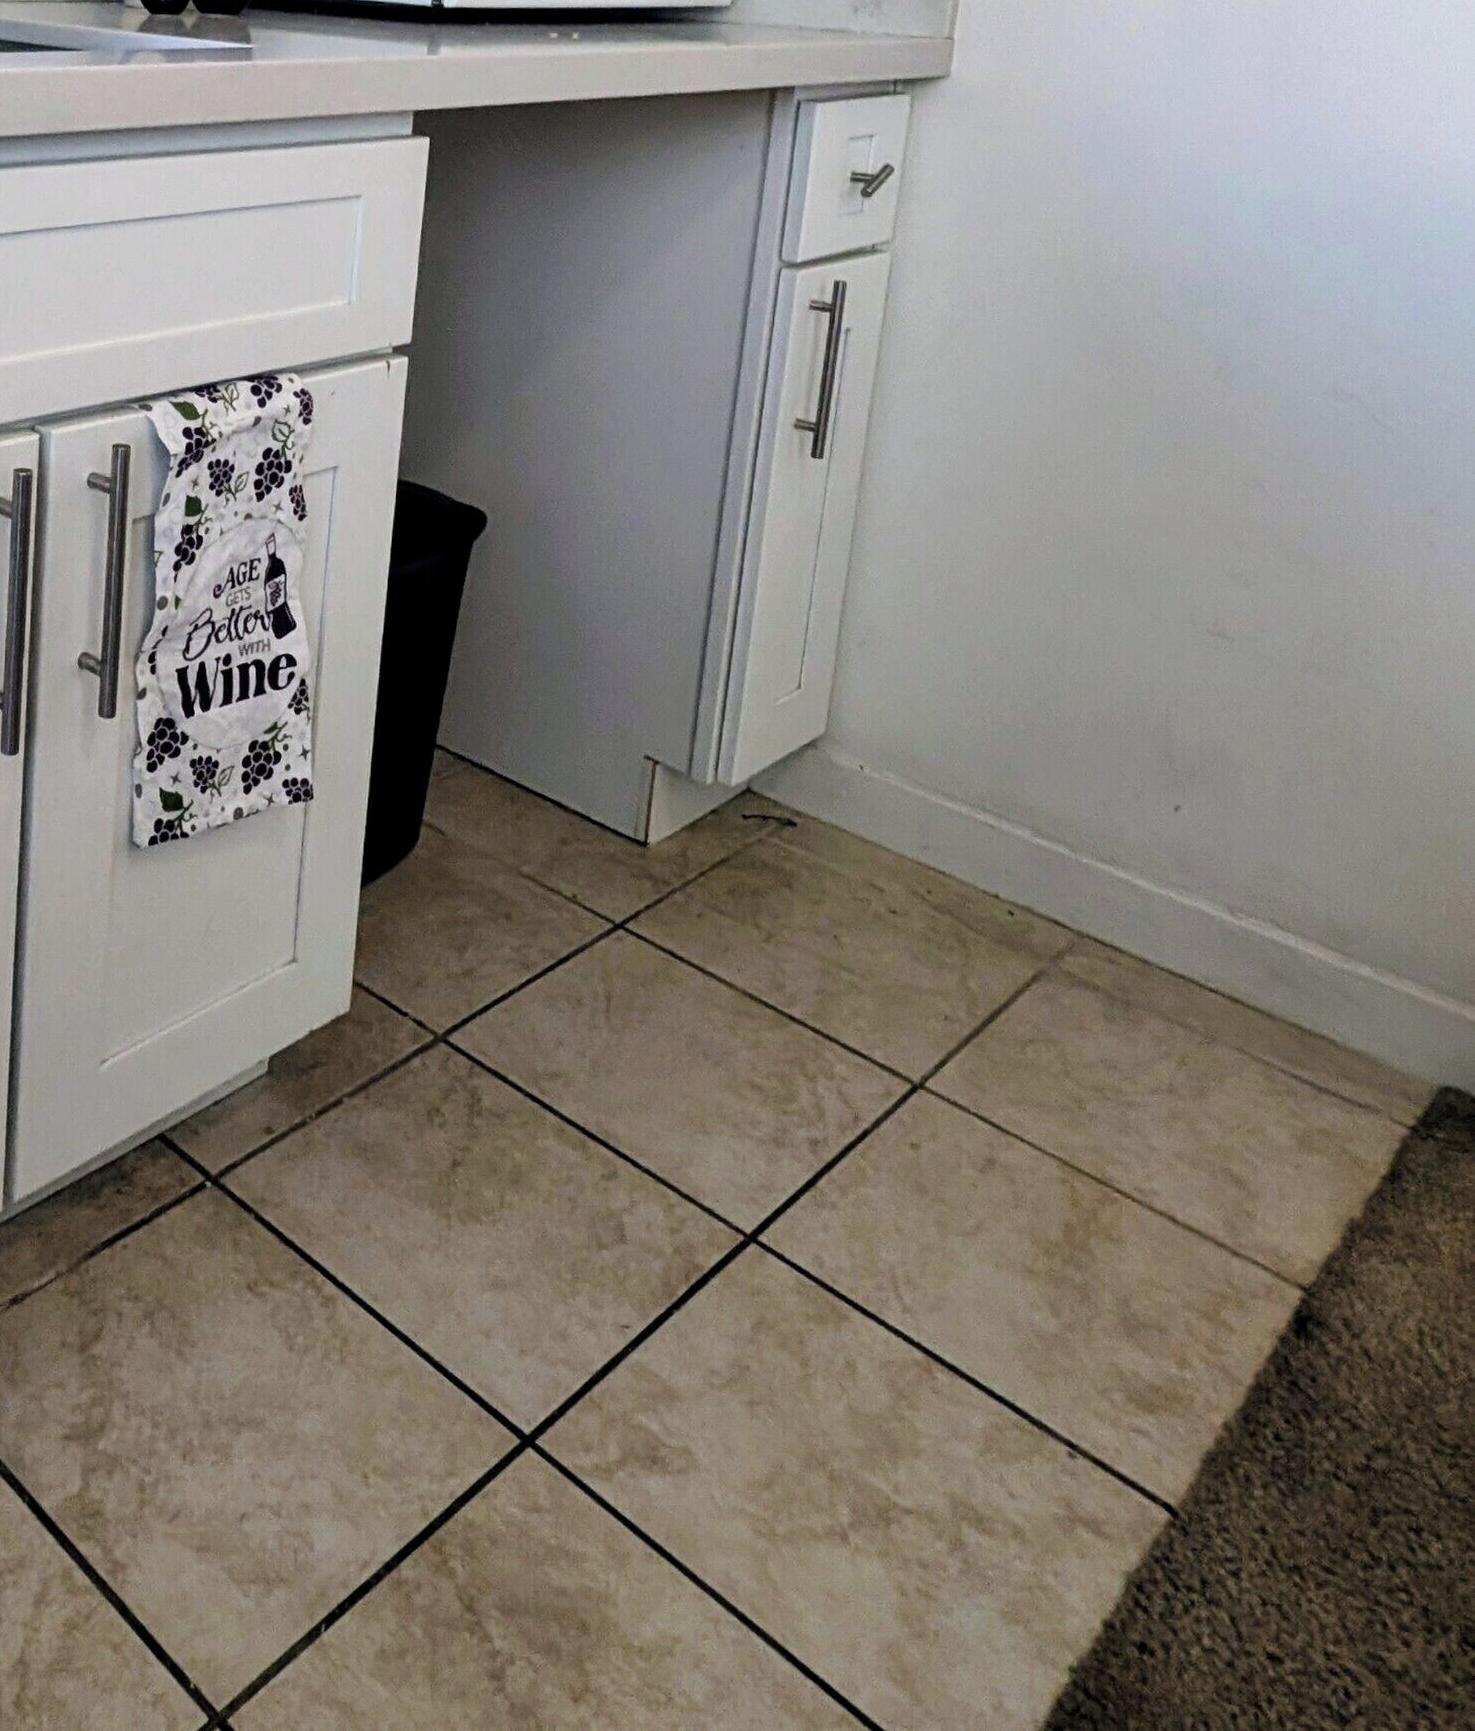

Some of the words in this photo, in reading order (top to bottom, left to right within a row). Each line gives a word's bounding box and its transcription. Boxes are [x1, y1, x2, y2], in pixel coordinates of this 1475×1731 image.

[213, 558, 261, 598] AGE
[226, 586, 251, 607] GETS
[182, 605, 273, 661] Better
[238, 638, 271, 656] WITH
[175, 653, 297, 719] Wine
